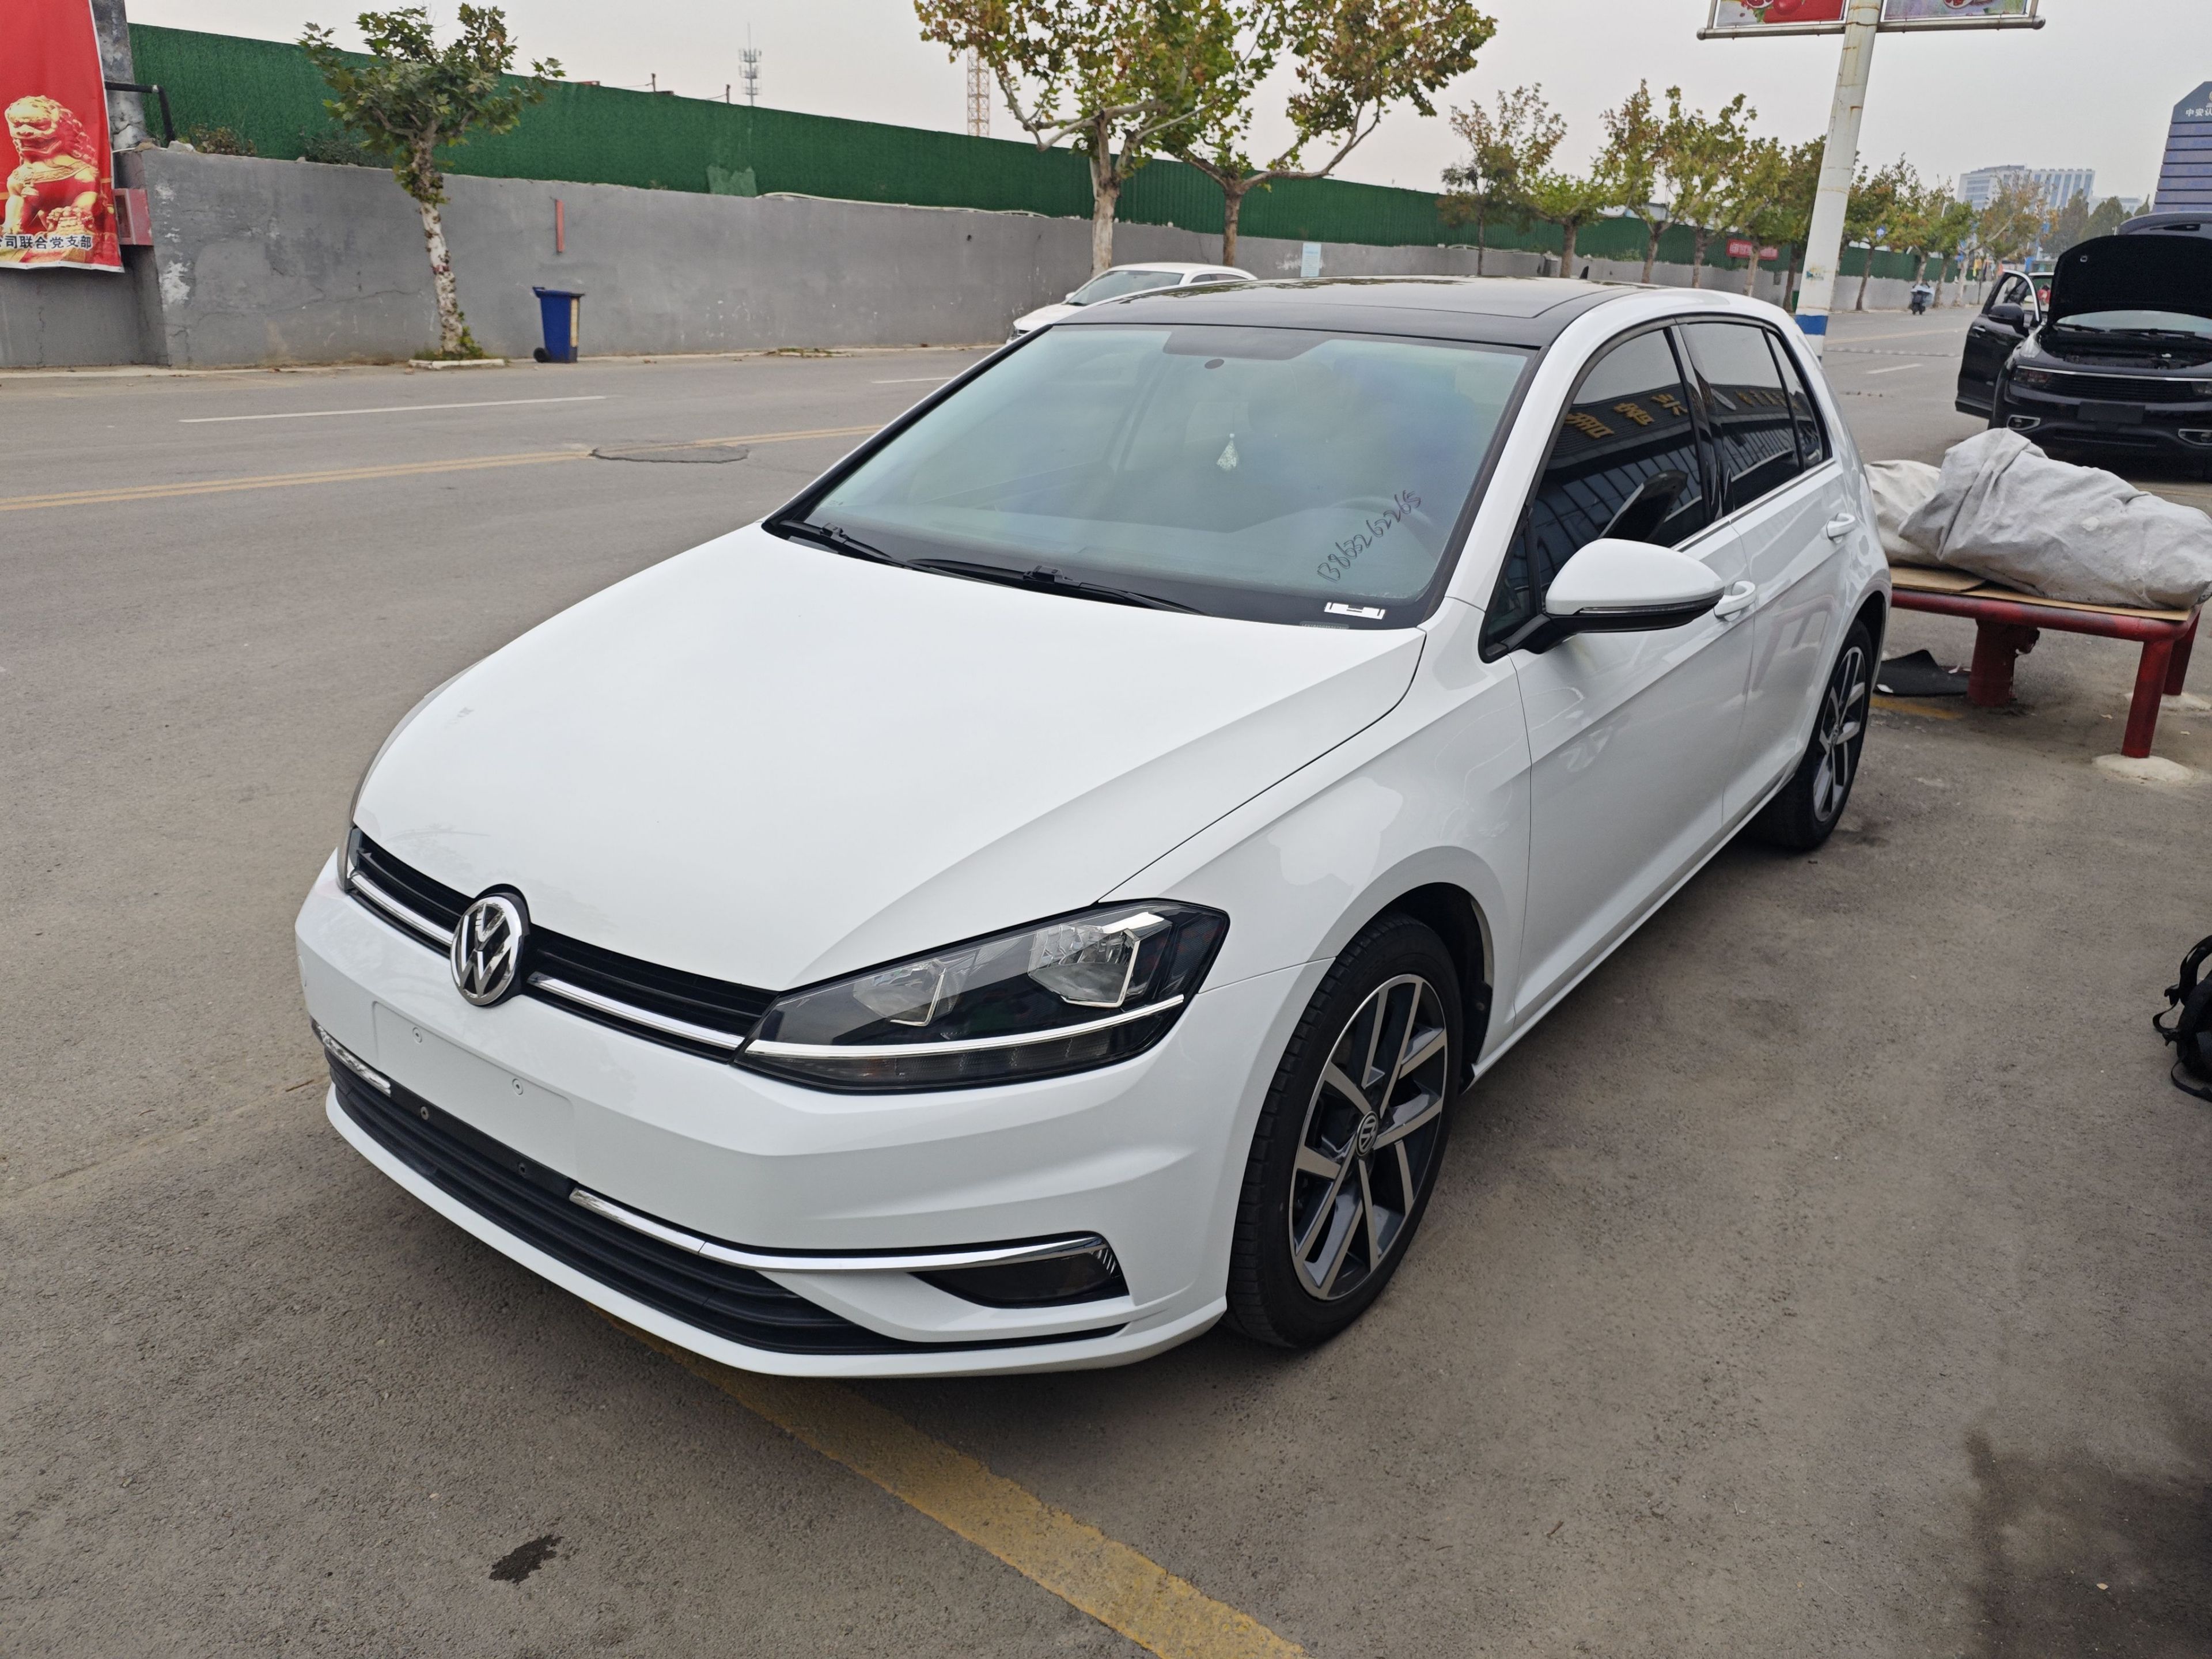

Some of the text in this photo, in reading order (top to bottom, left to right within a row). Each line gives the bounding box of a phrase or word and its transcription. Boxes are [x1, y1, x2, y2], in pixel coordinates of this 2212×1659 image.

[0, 235, 92, 249] 司联合党支部
